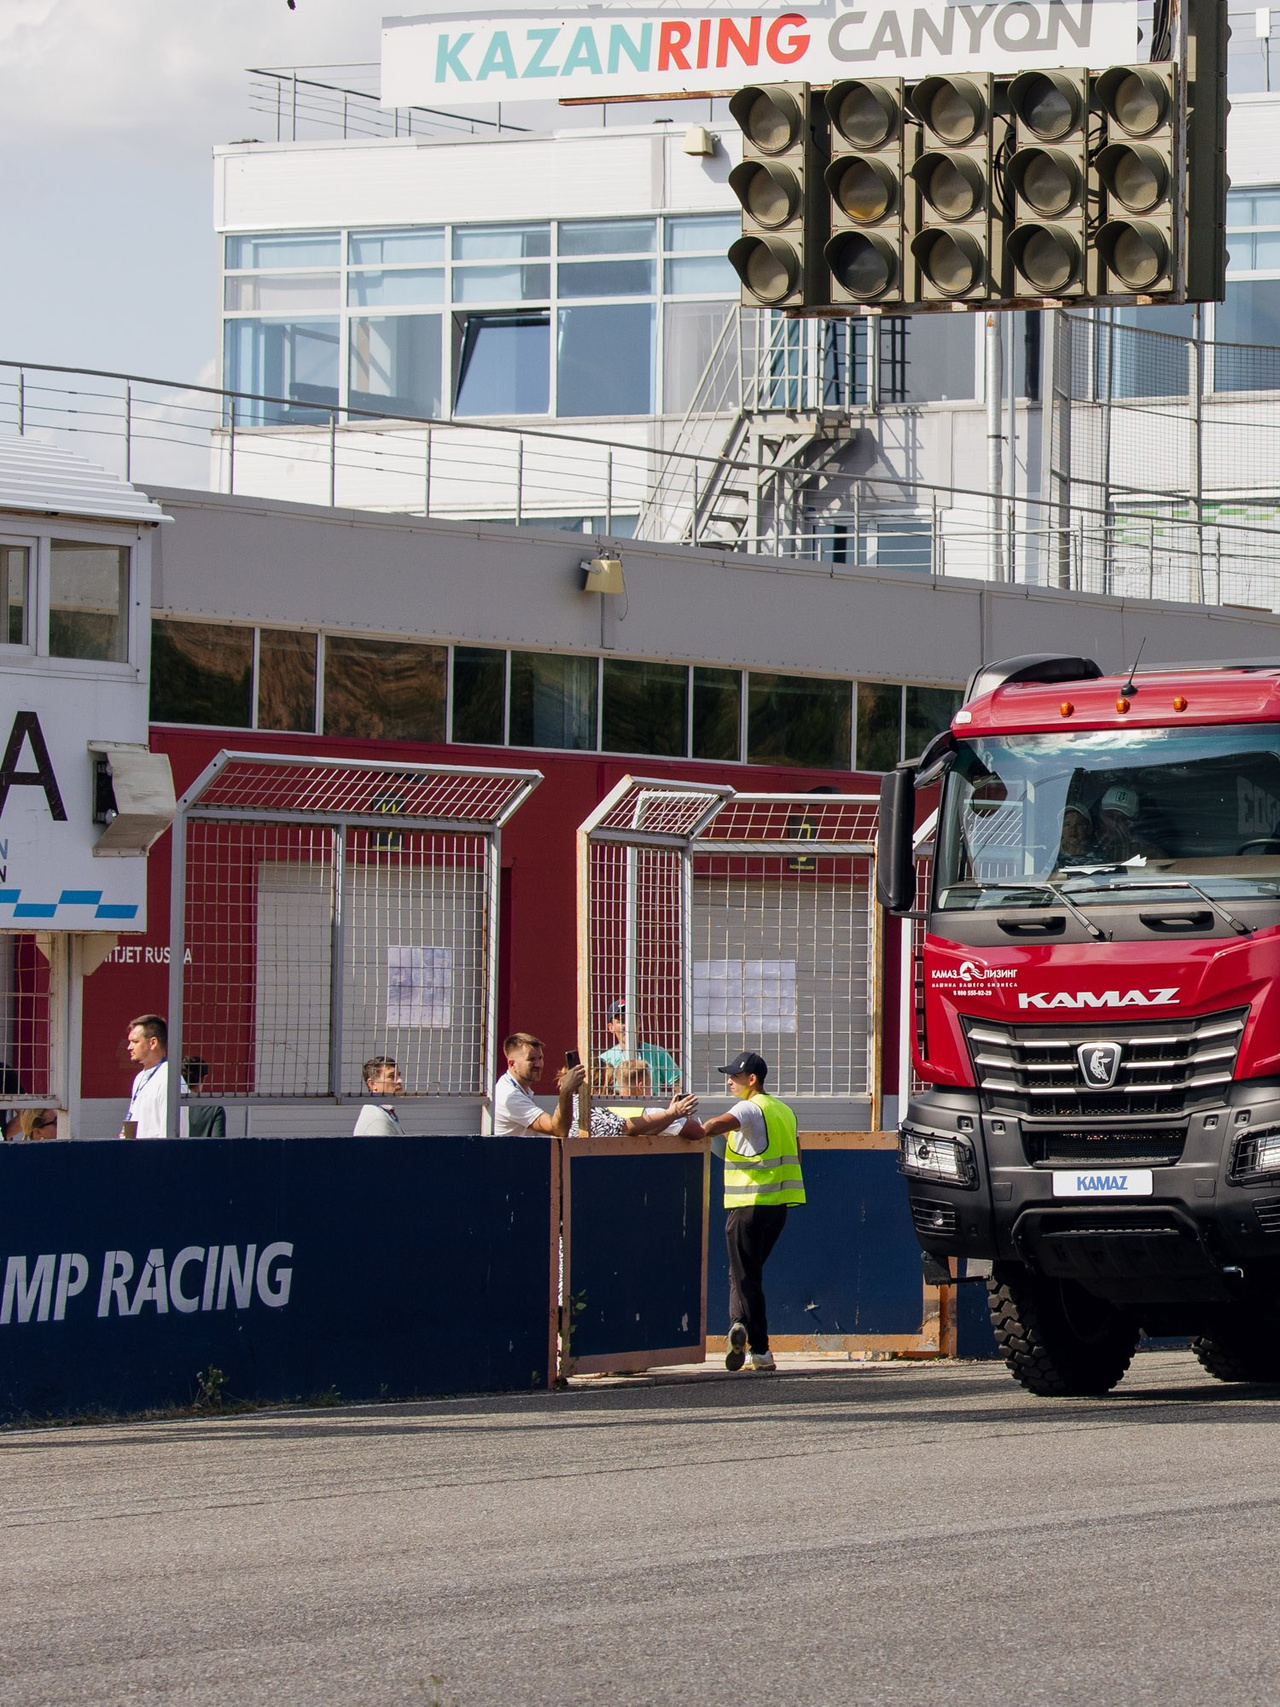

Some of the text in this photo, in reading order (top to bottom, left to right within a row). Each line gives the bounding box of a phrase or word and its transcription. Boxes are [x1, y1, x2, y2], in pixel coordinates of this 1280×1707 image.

[435, 0, 1094, 84] KAZANRING CANYON
[105, 946, 192, 964] ITJET RUSA
[932, 969, 1018, 978] КАМАЗ ЛИЗИНГ
[1018, 987, 1181, 1009] KAMAZ
[1077, 1176, 1128, 1191] KAMAZ
[0, 1241, 294, 1324] MP RACING
